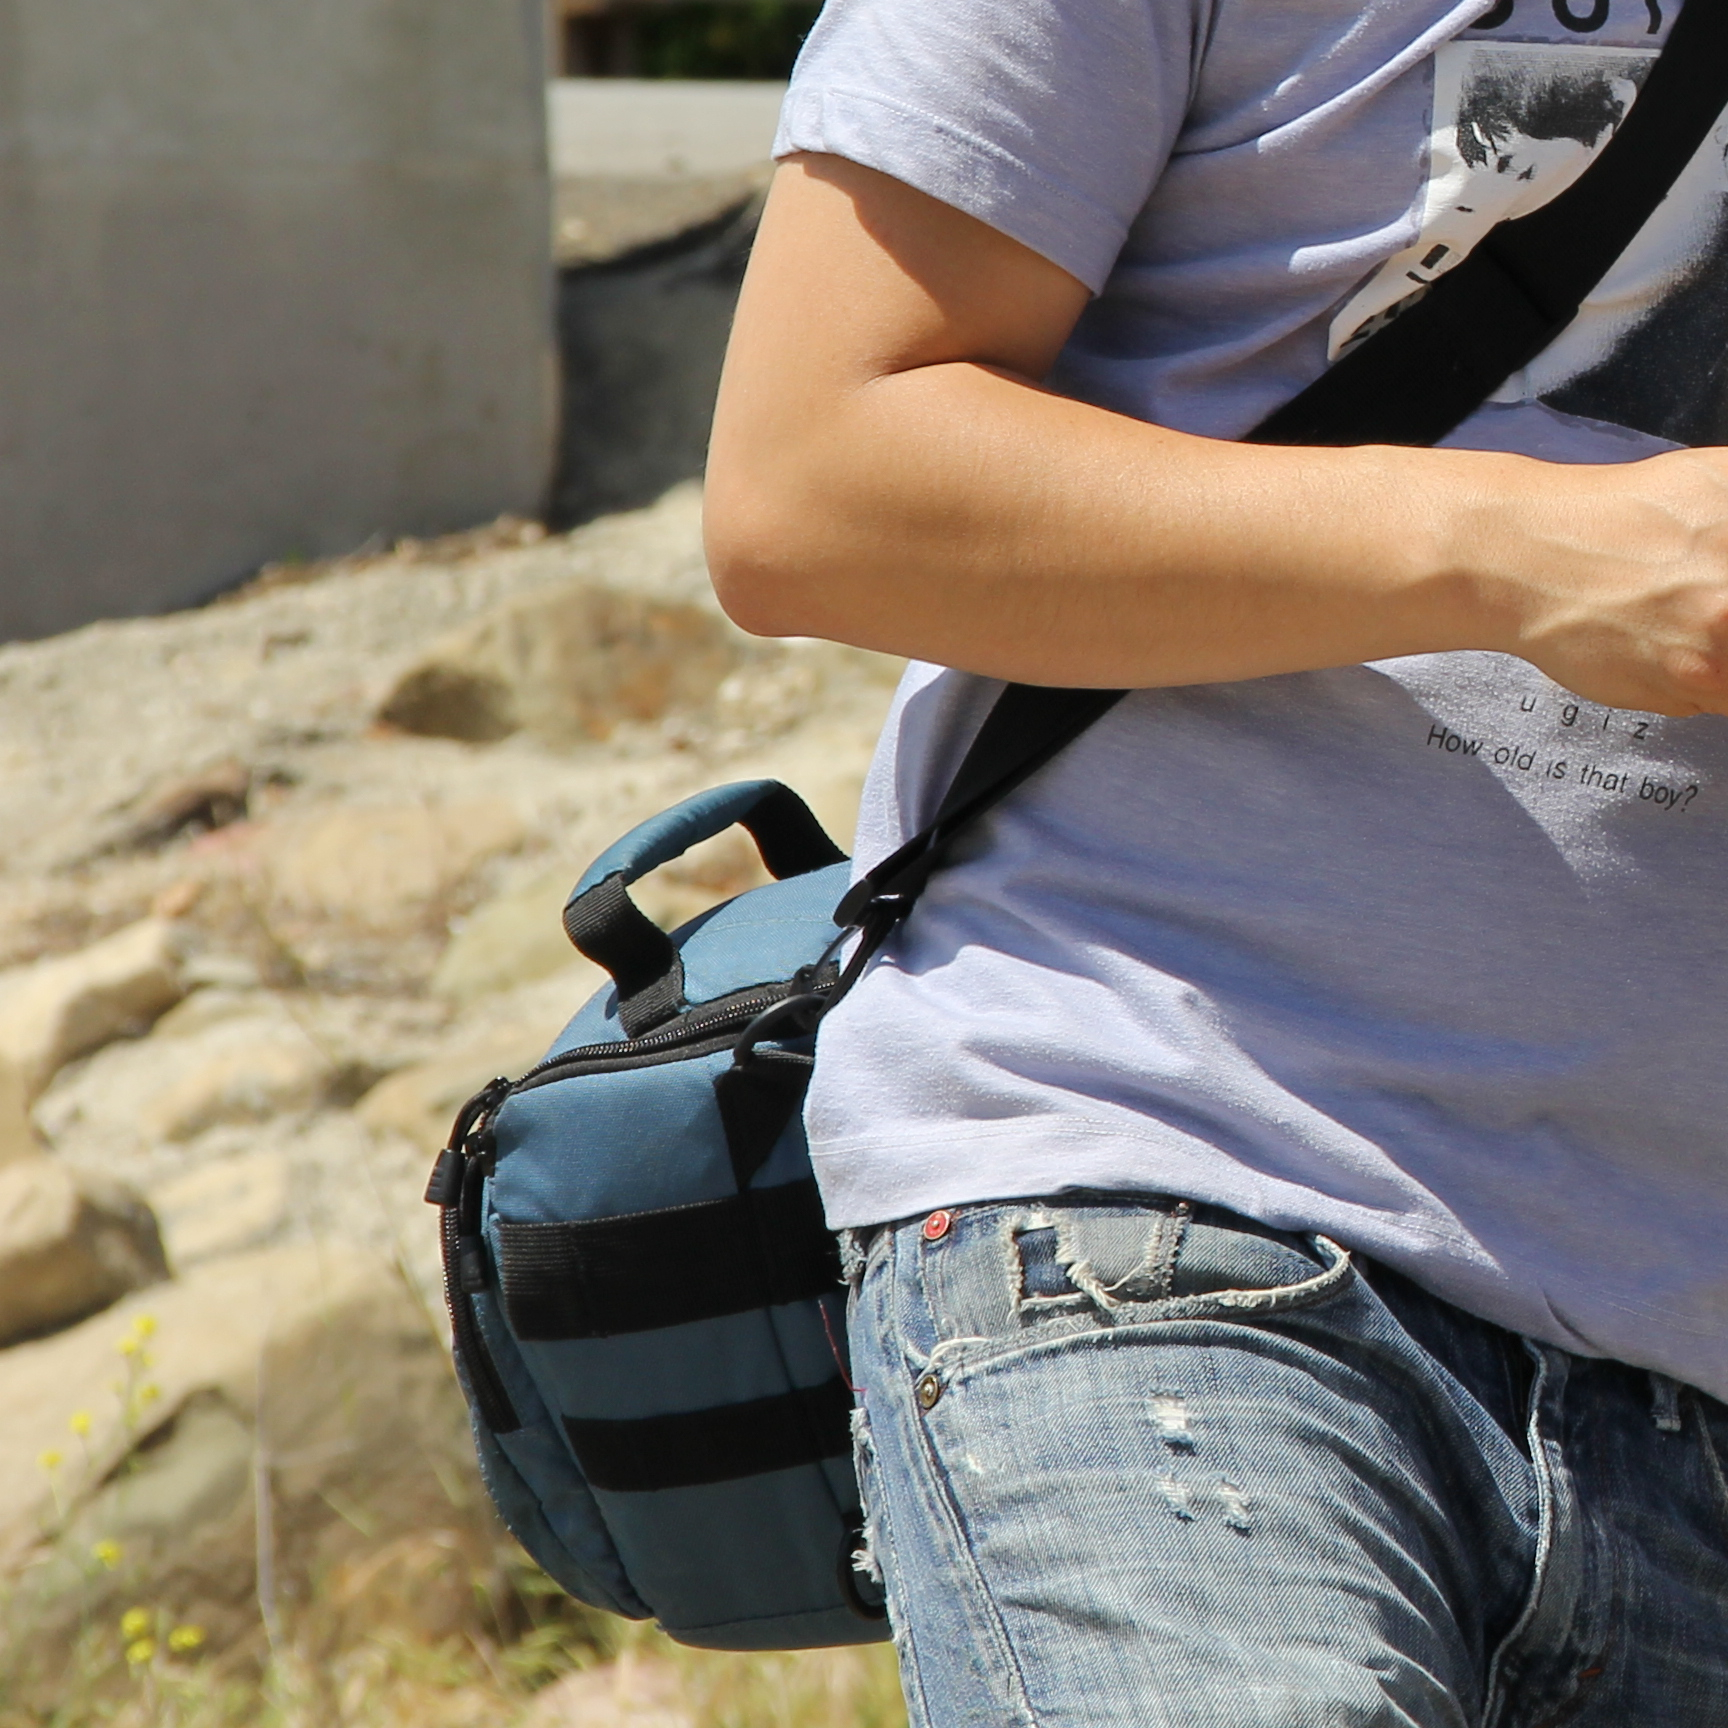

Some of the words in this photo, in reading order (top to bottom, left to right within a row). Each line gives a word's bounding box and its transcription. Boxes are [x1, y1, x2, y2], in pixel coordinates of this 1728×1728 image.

[1427, 723, 1484, 756] How
[1494, 745, 1537, 771] old
[1546, 760, 1568, 780] is
[1580, 764, 1630, 794] that
[1639, 778, 1699, 812] boy?
